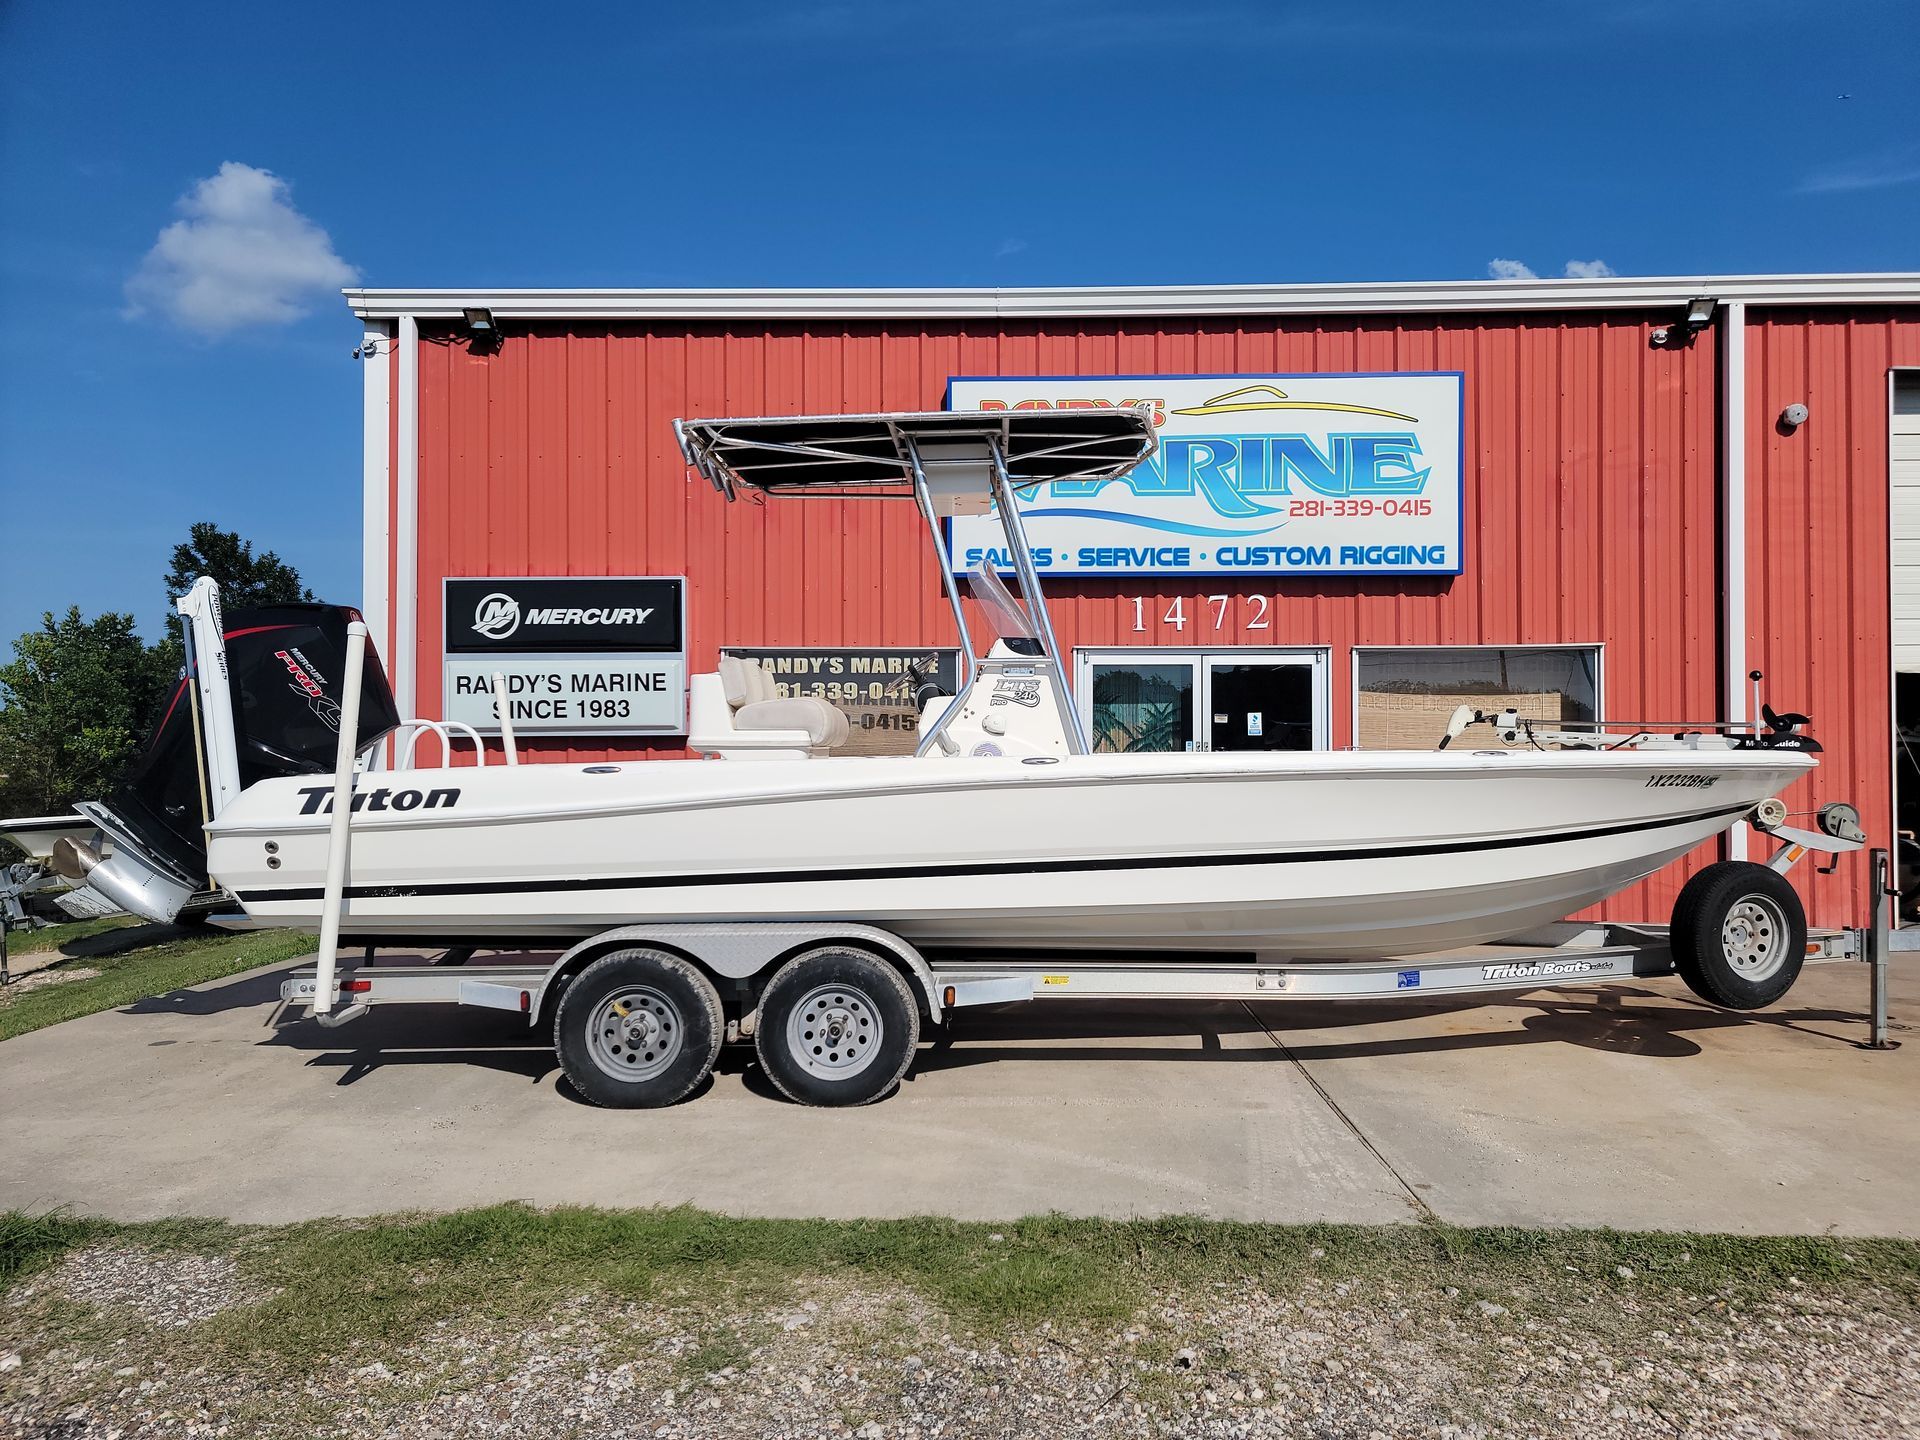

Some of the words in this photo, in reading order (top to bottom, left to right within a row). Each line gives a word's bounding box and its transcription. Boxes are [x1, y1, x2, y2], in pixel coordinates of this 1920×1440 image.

[1289, 499, 1432, 517] 281-339-0415
[965, 547, 1053, 568] SALS
[1078, 547, 1190, 567] SERVICE
[1215, 546, 1331, 567] CUSTOM
[1340, 545, 1445, 565] RIGGING
[525, 608, 655, 625] MERCURY
[274, 650, 323, 697] PRO
[290, 647, 328, 684] MERCURY
[571, 672, 667, 692] MARINE
[775, 682, 916, 700] 81-339-041
[577, 699, 631, 718] 1983
[1745, 739, 1801, 748] Mouide
[1482, 962, 1541, 980] Triton
[1541, 961, 1591, 976] Boats
